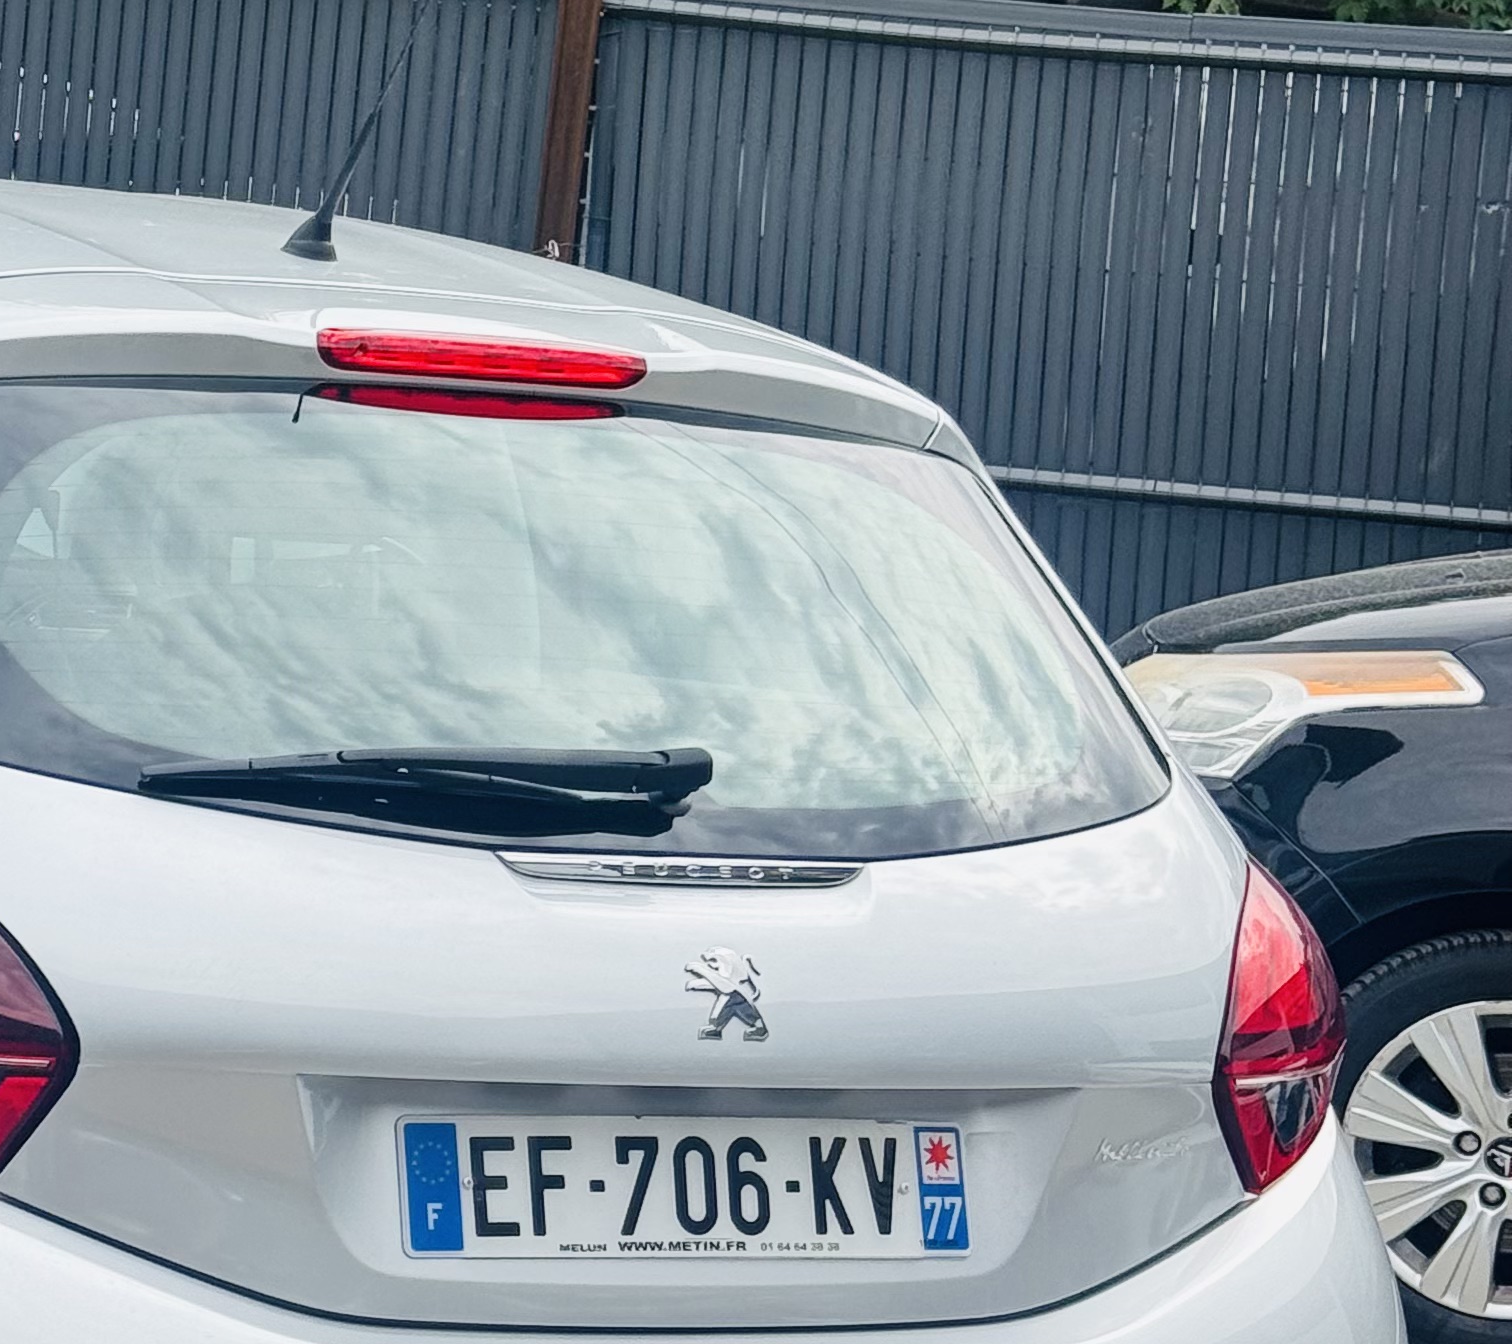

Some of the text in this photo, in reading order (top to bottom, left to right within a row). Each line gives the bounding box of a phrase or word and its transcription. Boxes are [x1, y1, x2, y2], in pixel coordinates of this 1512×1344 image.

[588, 860, 794, 880] PEUGEOT
[469, 1135, 897, 1237] EF-706-KV
[426, 1202, 443, 1231] F
[923, 1196, 963, 1241] 77
[559, 1243, 607, 1252] MELUN
[618, 1240, 747, 1252] WWW.METIN.FR
